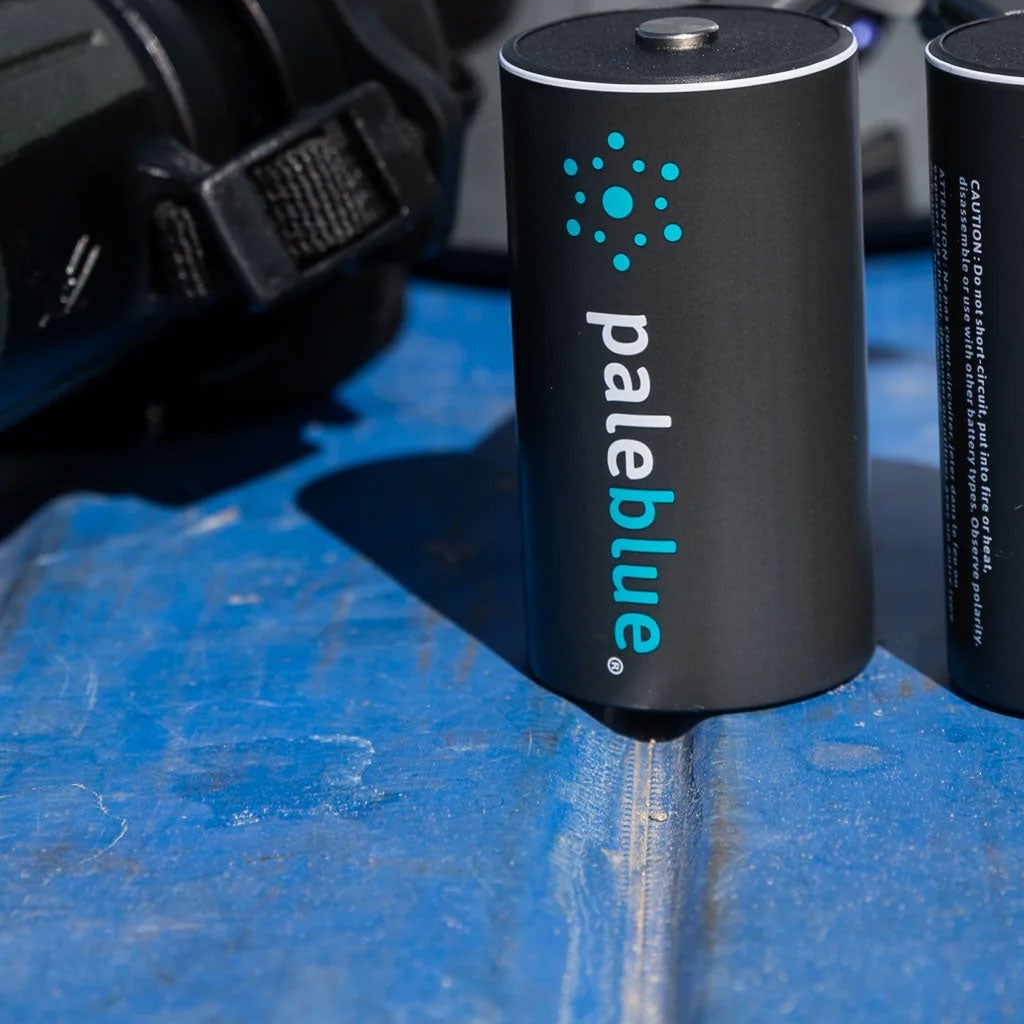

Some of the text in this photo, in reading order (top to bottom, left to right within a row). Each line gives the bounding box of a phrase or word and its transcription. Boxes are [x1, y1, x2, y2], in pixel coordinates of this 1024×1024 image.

[973, 264, 983, 286] Do
[974, 289, 984, 316] not
[975, 318, 988, 419] short-circuit,
[959, 176, 983, 647] disassemble or use with other battery types. Observe polarity.
[976, 422, 989, 448] put
[979, 451, 990, 482] into
[980, 485, 992, 513] fire
[981, 515, 991, 533] or
[982, 535, 993, 574] heat,
